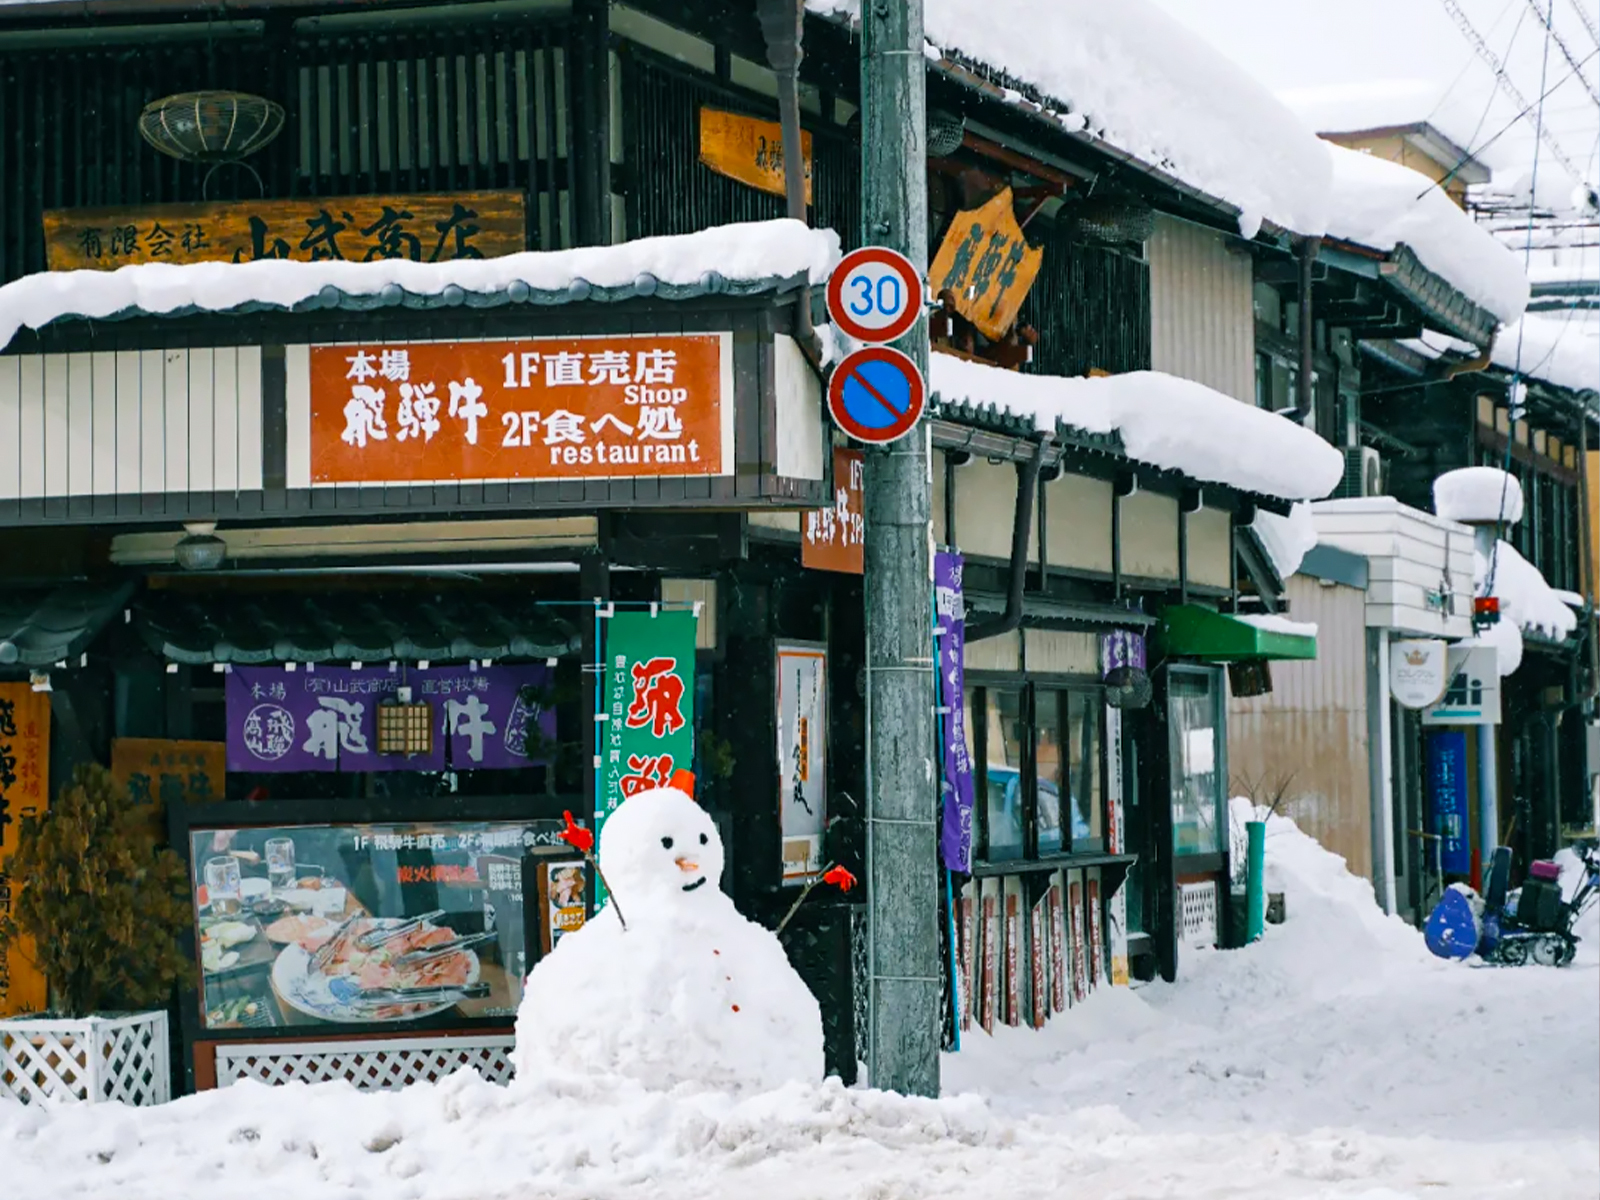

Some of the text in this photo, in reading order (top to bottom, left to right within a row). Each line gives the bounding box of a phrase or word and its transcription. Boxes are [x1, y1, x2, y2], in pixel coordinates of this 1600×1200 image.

[77, 222, 211, 259] 有限会社
[850, 275, 900, 316] 30
[345, 350, 410, 382] 本場
[624, 385, 687, 406] Shop
[341, 377, 487, 448] 飛騨牛
[550, 441, 700, 465] restaurant
[250, 682, 287, 700] 本場
[353, 835, 369, 851] 1F
